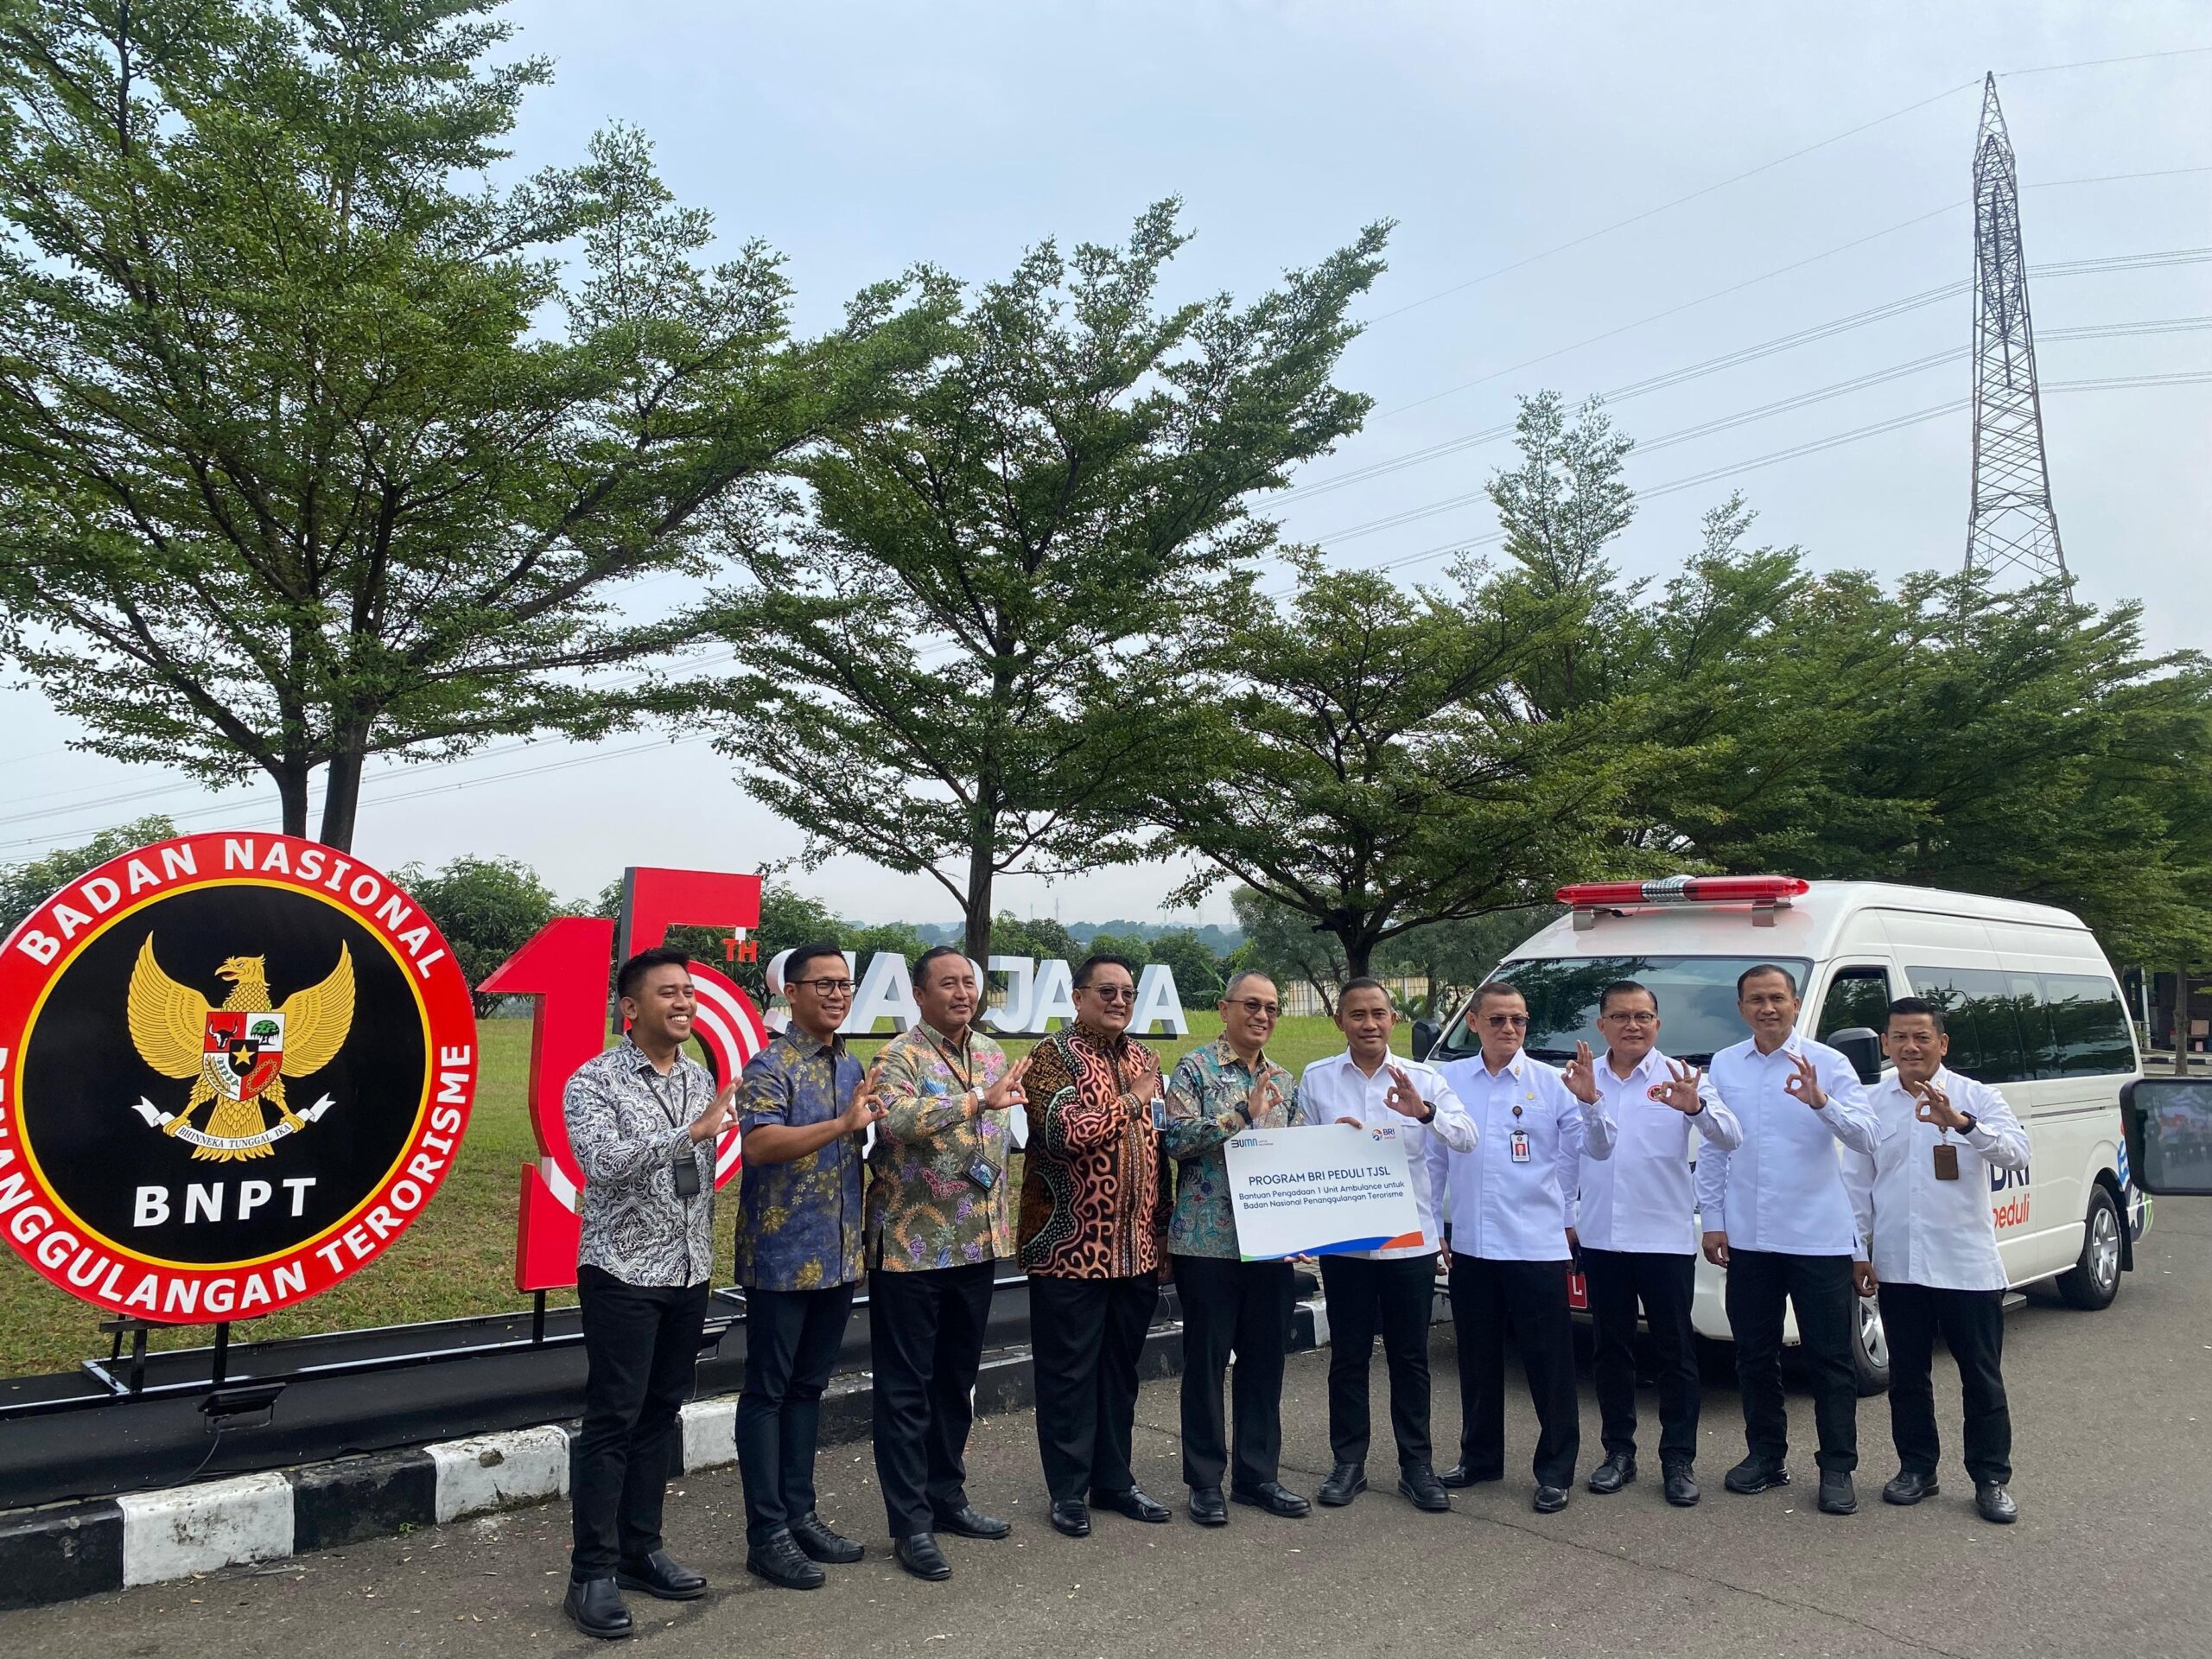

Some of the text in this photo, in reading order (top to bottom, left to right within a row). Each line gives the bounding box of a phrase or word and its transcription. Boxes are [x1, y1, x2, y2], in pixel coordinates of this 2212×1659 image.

[16, 838, 445, 979] BADAN NASIONAL
[980, 954, 1189, 1035] JAA
[179, 1124, 291, 1148] BHINNEKA TUNGGAL IKA
[1382, 1128, 1395, 1136] BRI
[0, 1045, 470, 1314] NGGULANGAN TERORISME
[1249, 1166, 1391, 1186] PROGRAM BRI PEDULI TJSL
[133, 1177, 317, 1228] BNPT
[1238, 1192, 1271, 1201] Bantuan
[1272, 1188, 1316, 1198] Pengadaan
[1323, 1185, 1338, 1194] Unit
[1339, 1183, 1382, 1192] Ambulance
[1383, 1180, 1405, 1189] untuk
[1243, 1191, 1404, 1210] Badan Nasional Penanggulangan Terorisme
